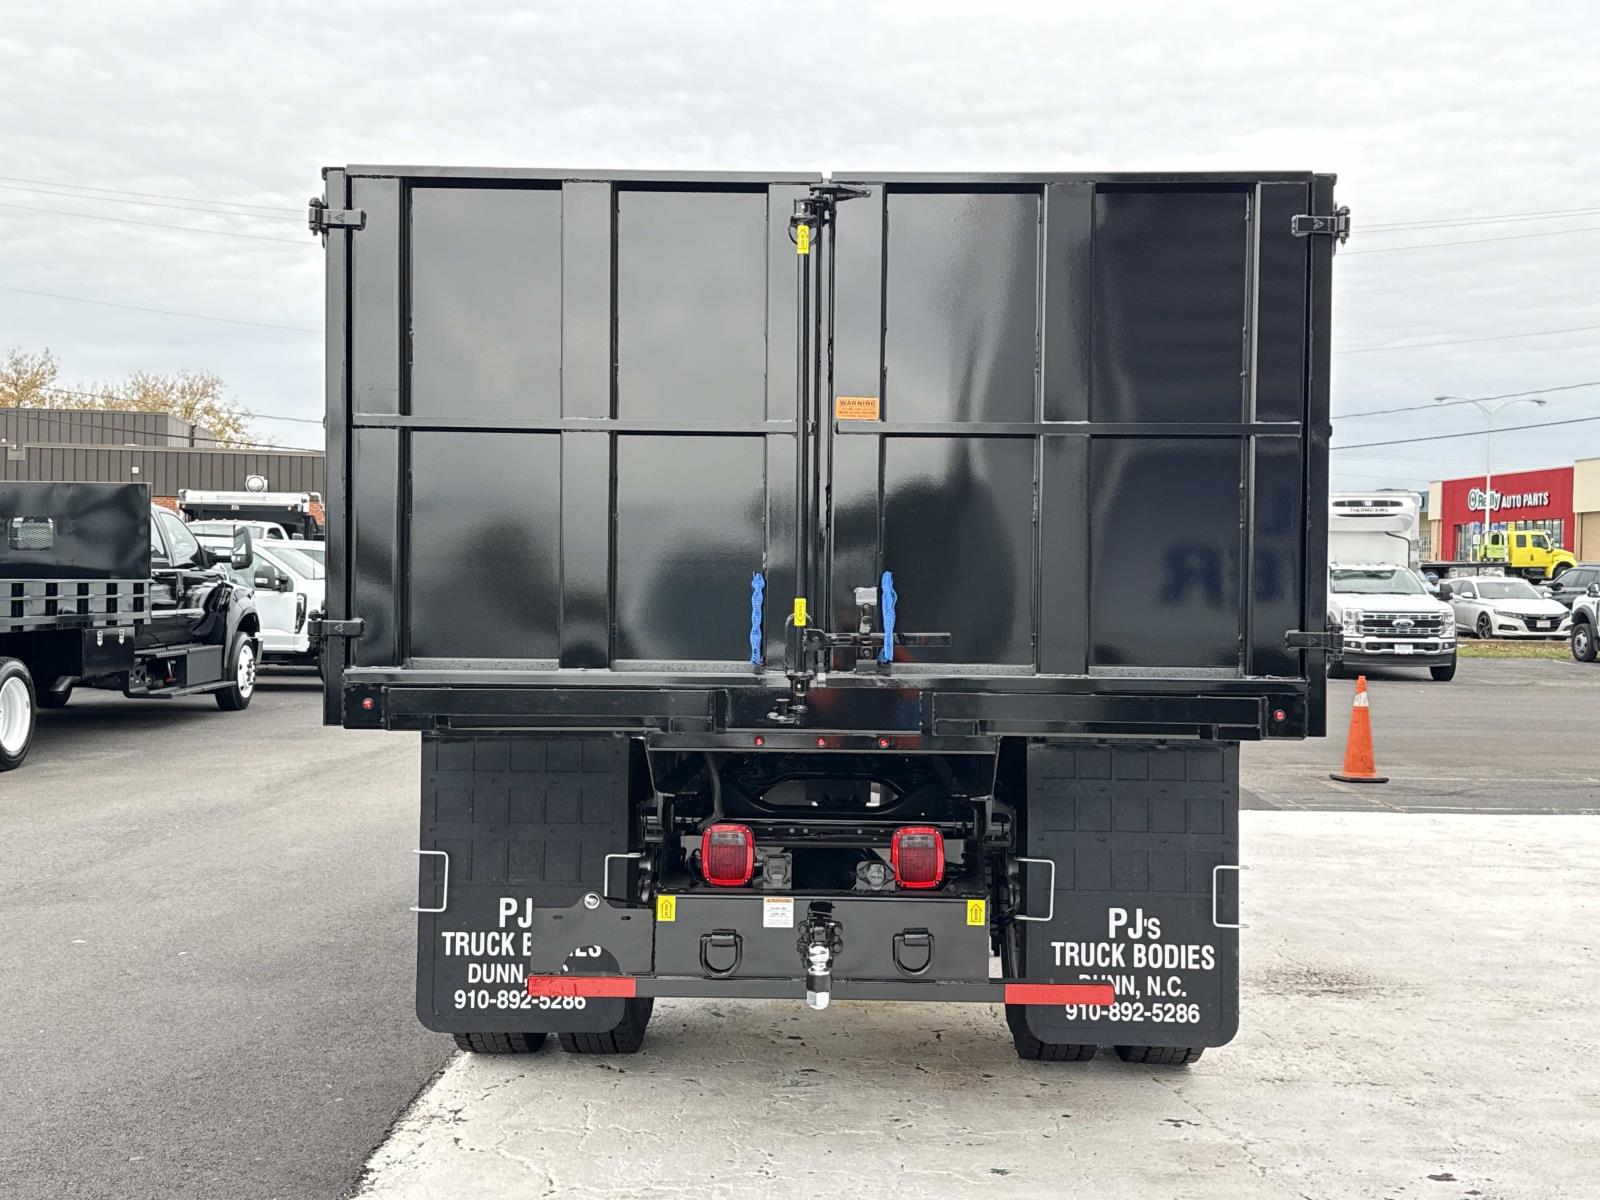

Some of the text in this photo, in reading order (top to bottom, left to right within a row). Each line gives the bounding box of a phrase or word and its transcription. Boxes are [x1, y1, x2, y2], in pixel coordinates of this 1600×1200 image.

[1468, 489, 1549, 511] O'Relly AUTO PARTS
[1108, 907, 1161, 940] PJ's
[442, 931, 515, 957] TRUCK
[1051, 942, 1216, 970] TRUCK BODIES
[1078, 974, 1187, 999] NN, N.C.
[454, 989, 587, 1010] 910-892-5286
[1065, 1001, 1201, 1024] 910-892-5286
